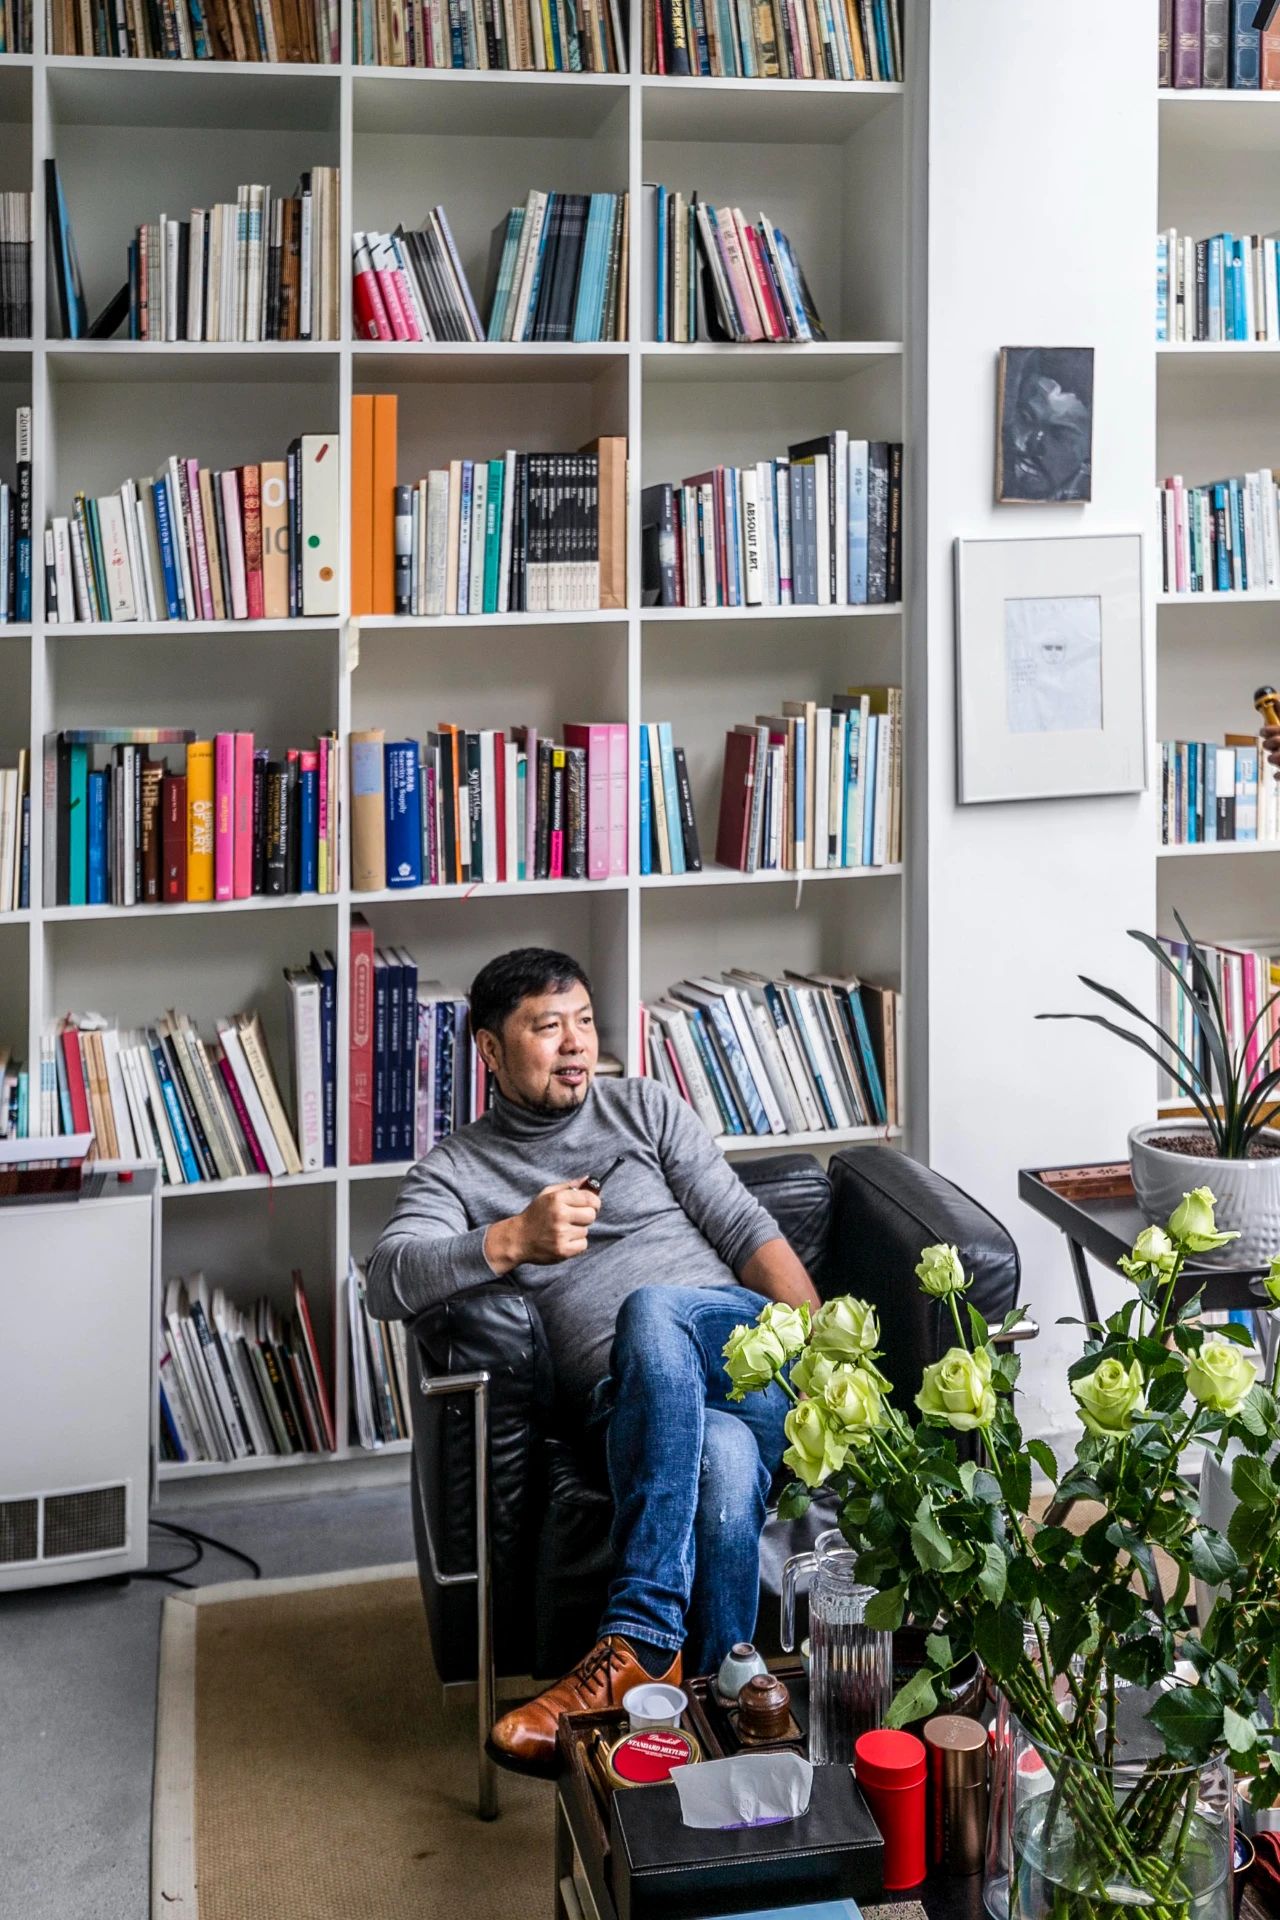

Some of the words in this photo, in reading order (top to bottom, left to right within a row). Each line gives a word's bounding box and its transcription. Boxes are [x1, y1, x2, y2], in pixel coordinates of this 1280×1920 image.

[157, 488, 168, 545] TRANSITION
[191, 489, 203, 531] MOSAICS
[195, 533, 204, 544] OF
[746, 501, 758, 550] ABSOLUT
[198, 545, 210, 591] MALAYSIA
[748, 552, 759, 573] ART.
[398, 750, 406, 779] Scarcity
[193, 800, 205, 820] OF
[397, 789, 408, 814] Supply
[193, 825, 205, 855] ART
[304, 1089, 319, 1147] CHINA
[627, 1740, 661, 1751] STANDARD
[660, 1746, 689, 1757] MIXTURE
